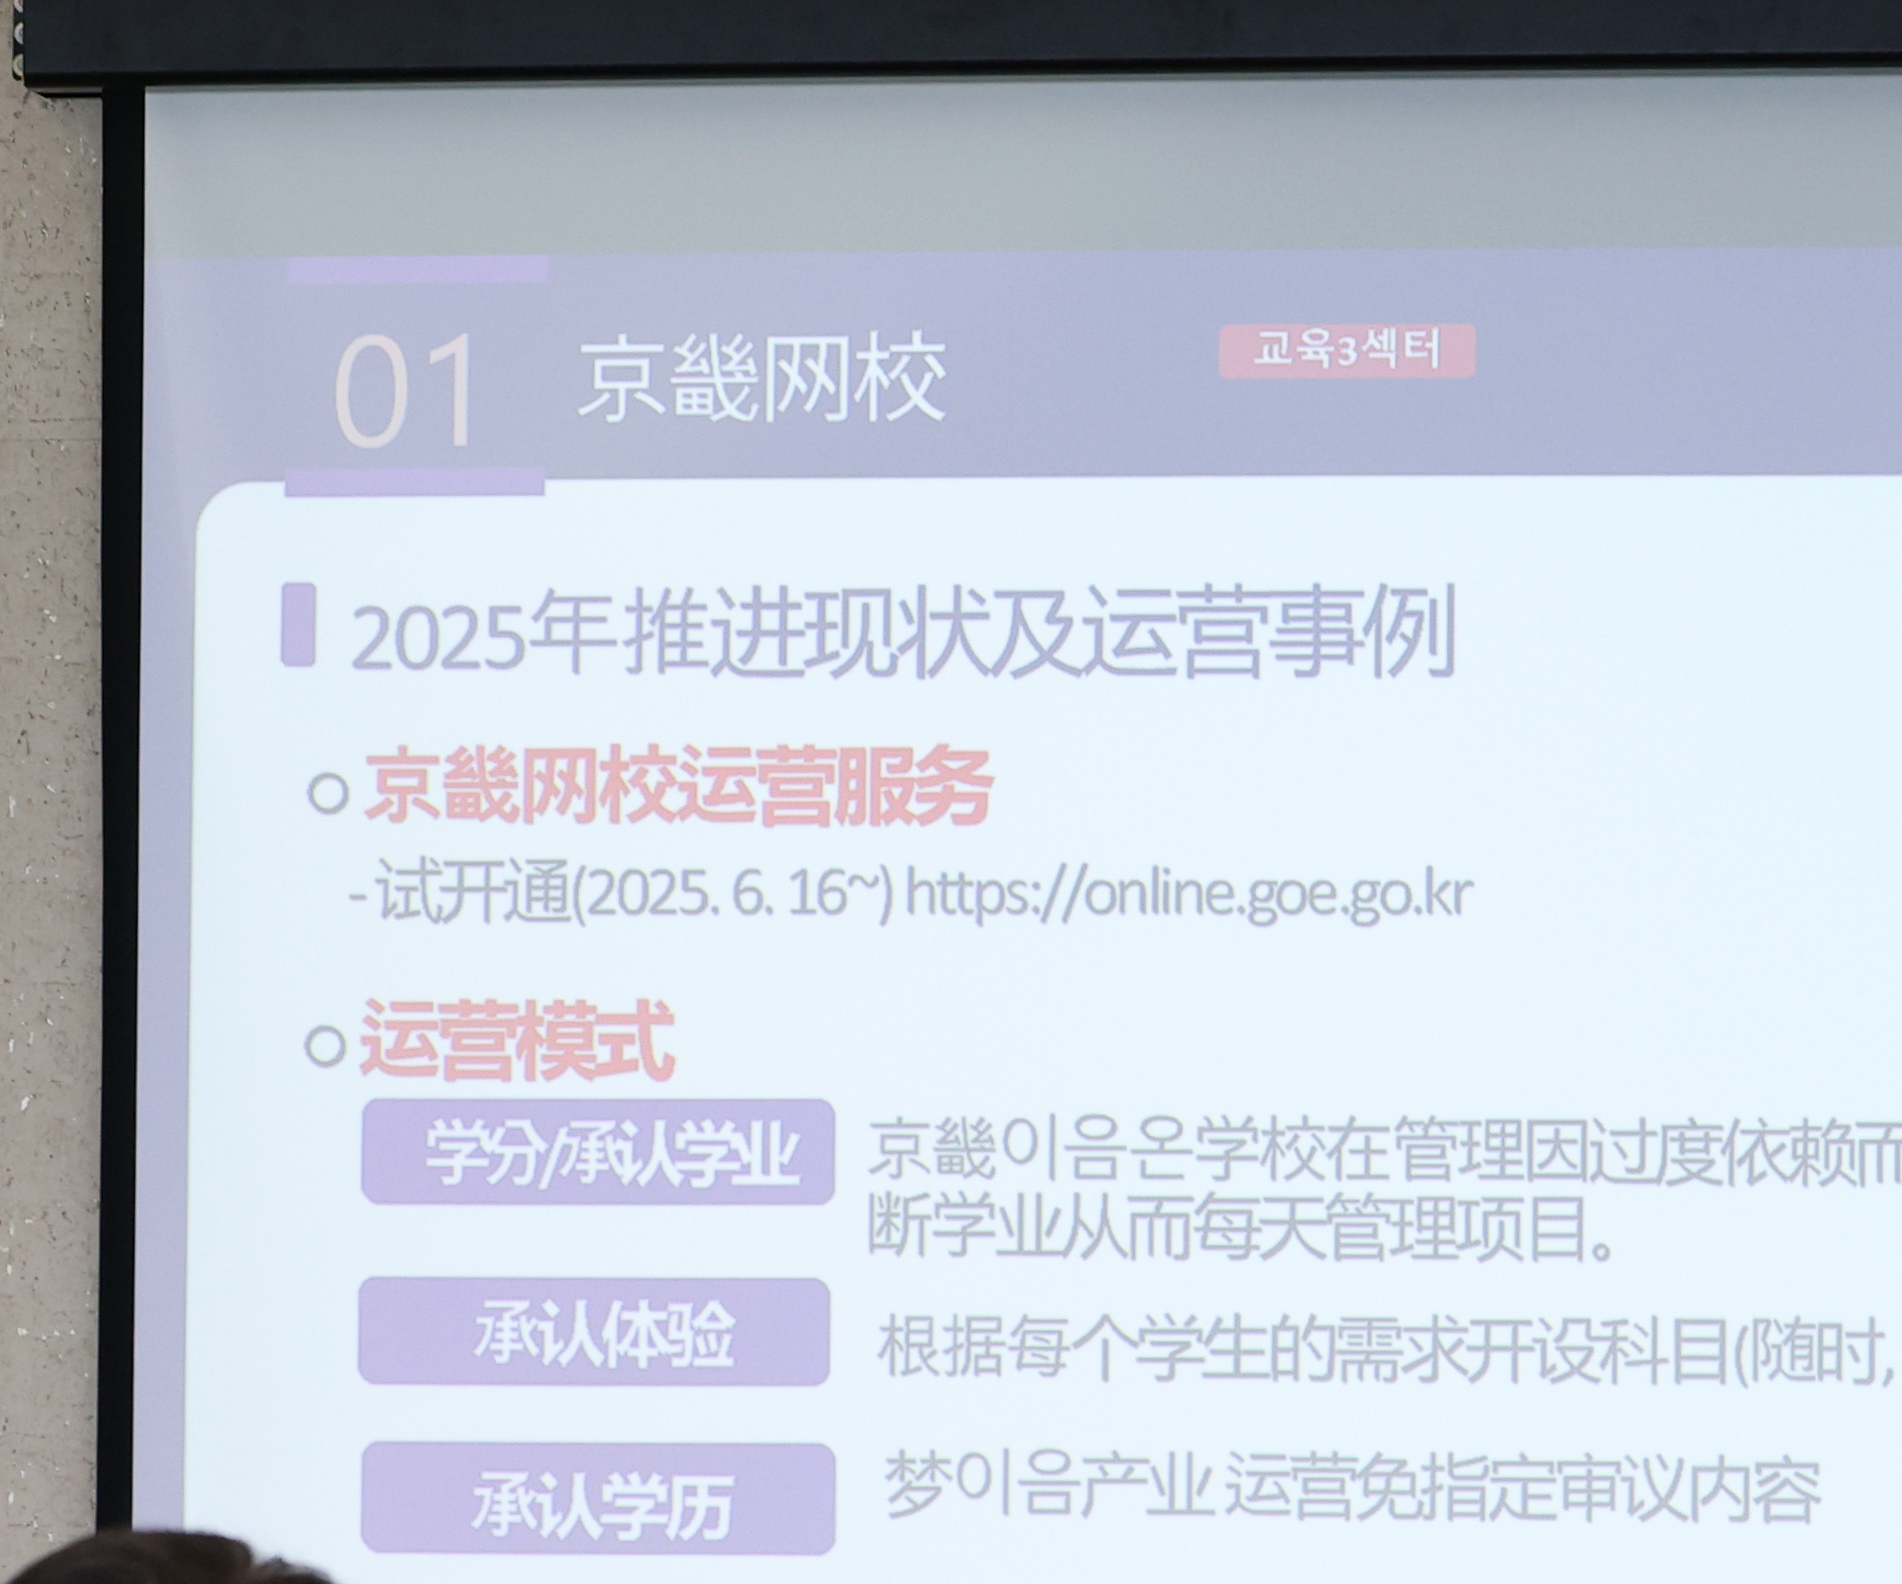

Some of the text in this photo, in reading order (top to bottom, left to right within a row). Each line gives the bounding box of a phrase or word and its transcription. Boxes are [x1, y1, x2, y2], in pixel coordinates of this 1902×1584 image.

[1252, 325, 1443, 372] 교육3섹터
[334, 329, 948, 450] 01 京畿网校
[351, 581, 1458, 681] 2025年推进现状及运营事例
[363, 742, 996, 828] 京畿网校运营服务
[907, 859, 1475, 929] https://online.goe.go.kr
[358, 997, 678, 1084] 运营模式
[425, 1116, 801, 1191] 学分/承认学业
[867, 1189, 1611, 1264] 断学业从而每天管理项目。
[472, 1297, 738, 1371] 承认体验
[471, 1470, 737, 1542] 承认学历
[1223, 1450, 1823, 1525] 运营免指定审议内容
